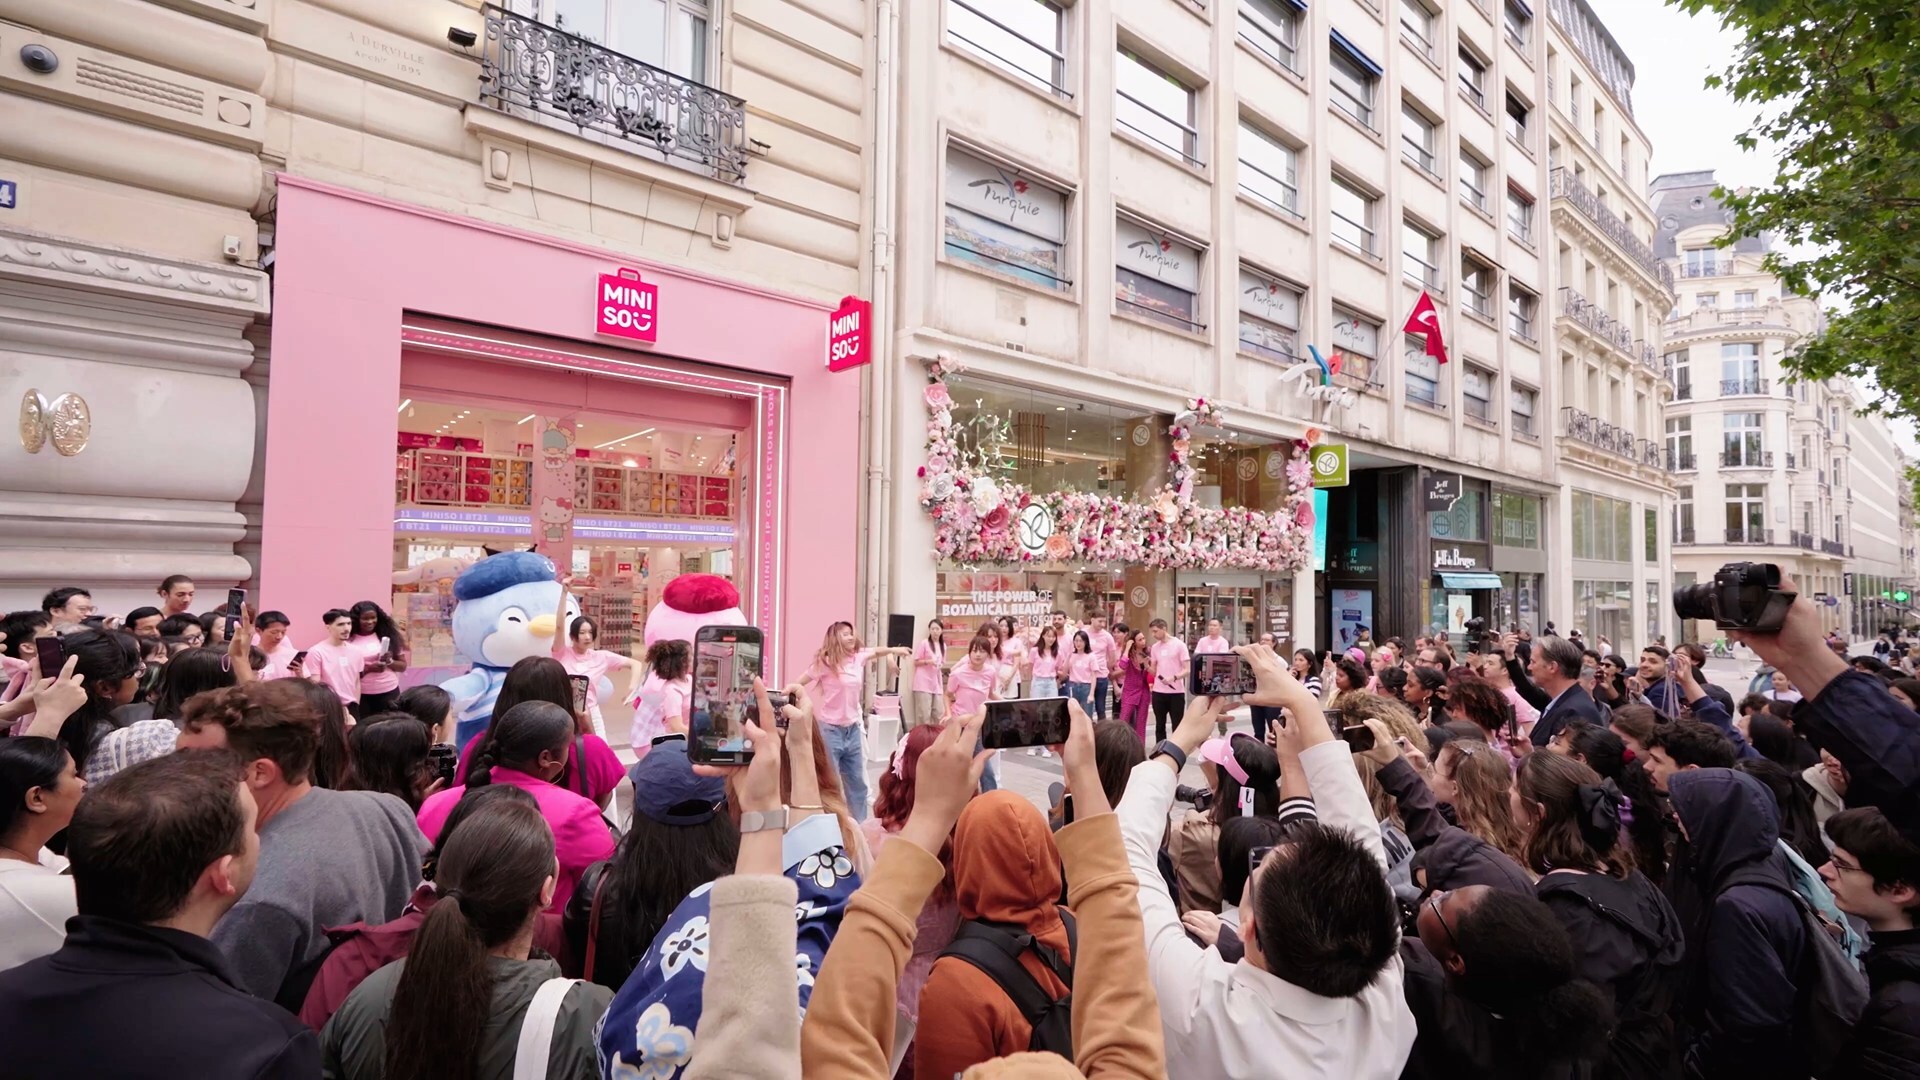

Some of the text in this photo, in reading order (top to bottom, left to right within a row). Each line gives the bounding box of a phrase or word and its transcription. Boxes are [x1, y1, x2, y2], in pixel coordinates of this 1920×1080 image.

[967, 178, 1041, 222] Turquie
[1127, 240, 1181, 276] Turquie
[604, 282, 653, 311] MINI
[831, 311, 860, 339] MINI
[421, 511, 457, 520] MINISO
[497, 515, 531, 523] MINISO
[440, 523, 476, 533] MINISO
[764, 541, 772, 589] MINISO
[942, 602, 1053, 617] BOTANICAL BEAUTY
[971, 589, 1053, 603] THE POWER OF
